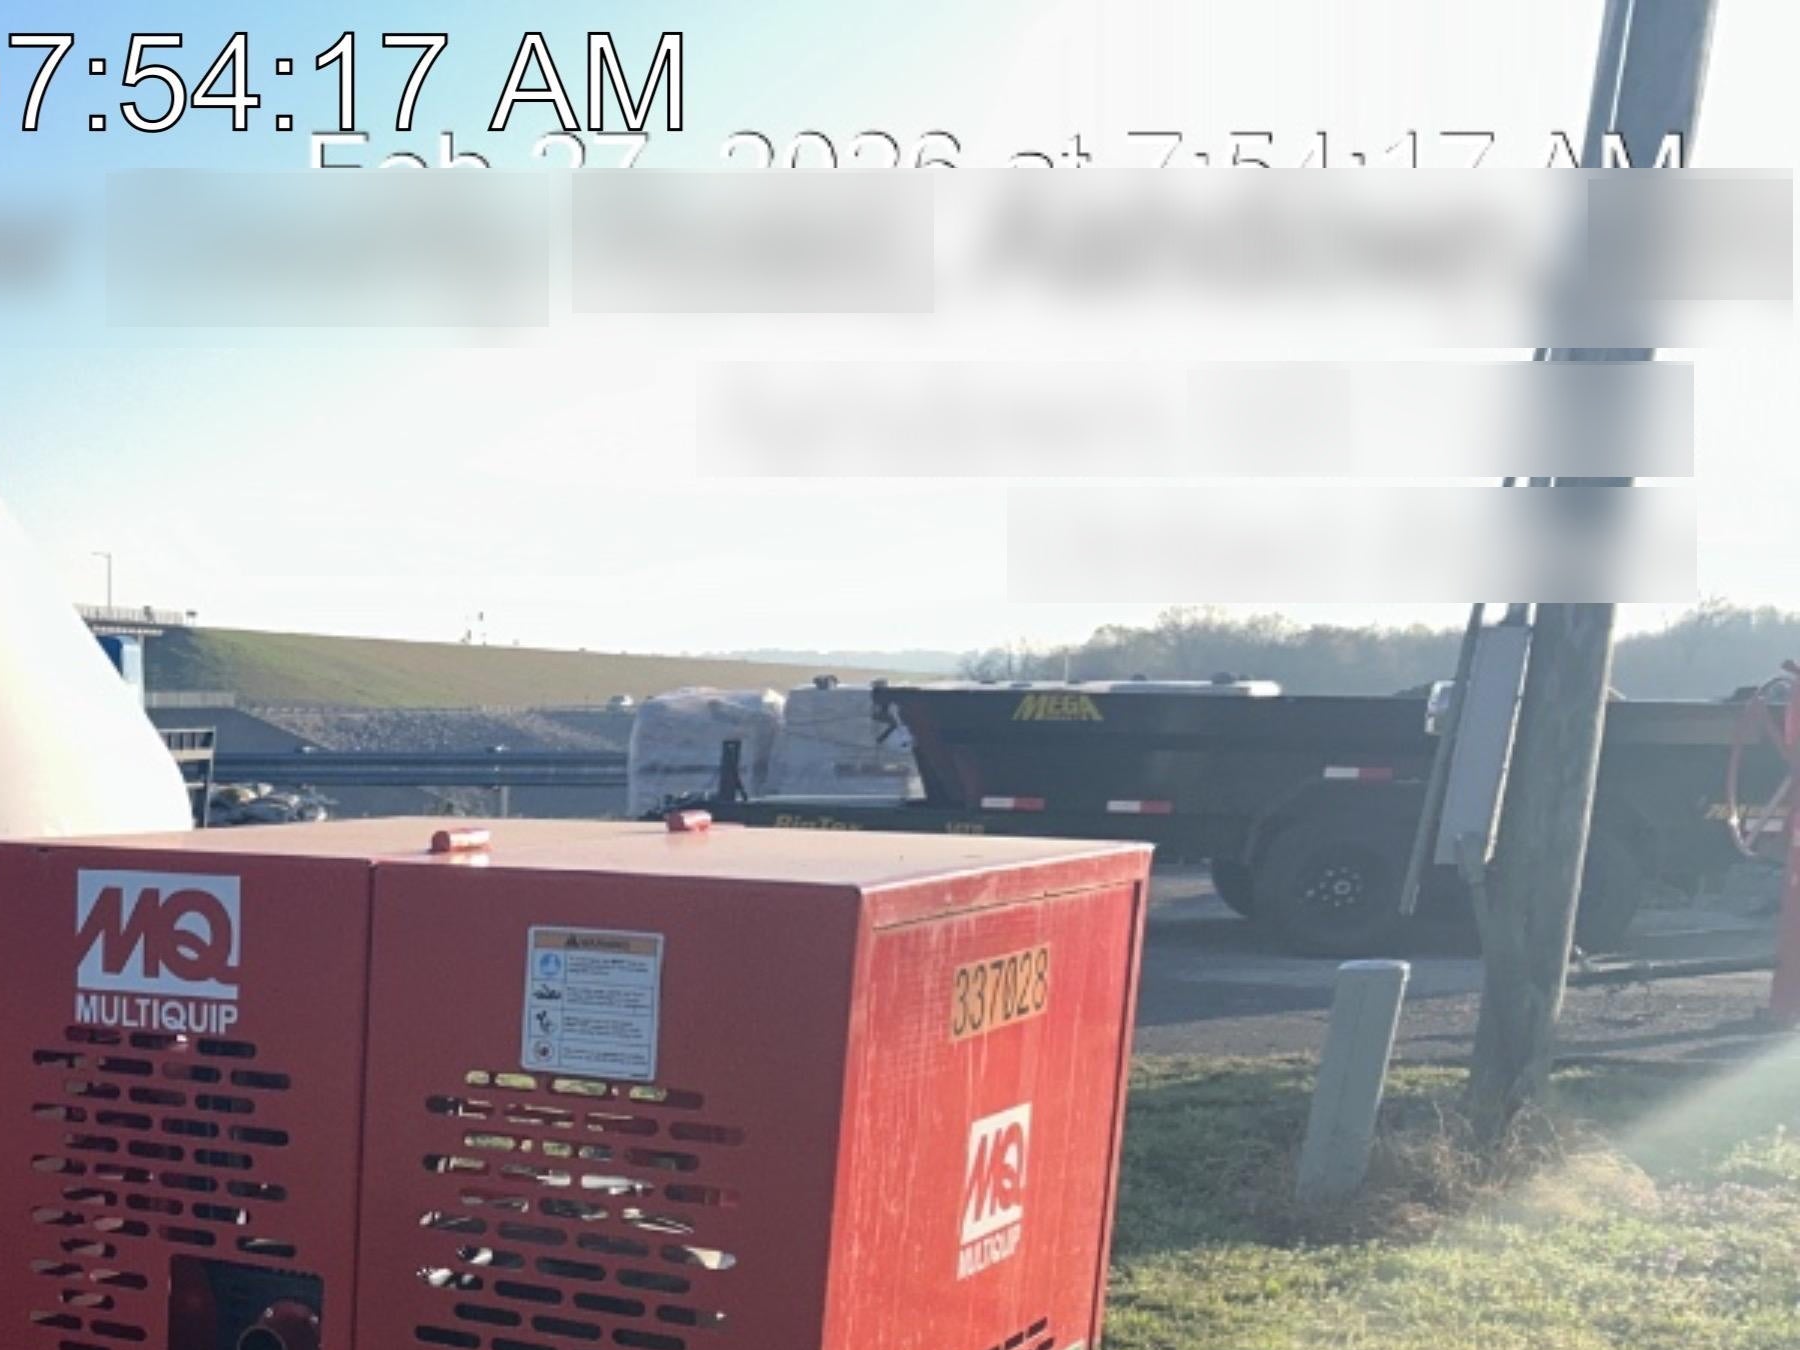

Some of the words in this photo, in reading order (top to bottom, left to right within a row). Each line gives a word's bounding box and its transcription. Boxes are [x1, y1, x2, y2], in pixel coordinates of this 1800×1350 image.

[1011, 694, 1104, 721] MEGA
[75, 880, 241, 992] MQ
[75, 993, 238, 1035] MULTIQUIP
